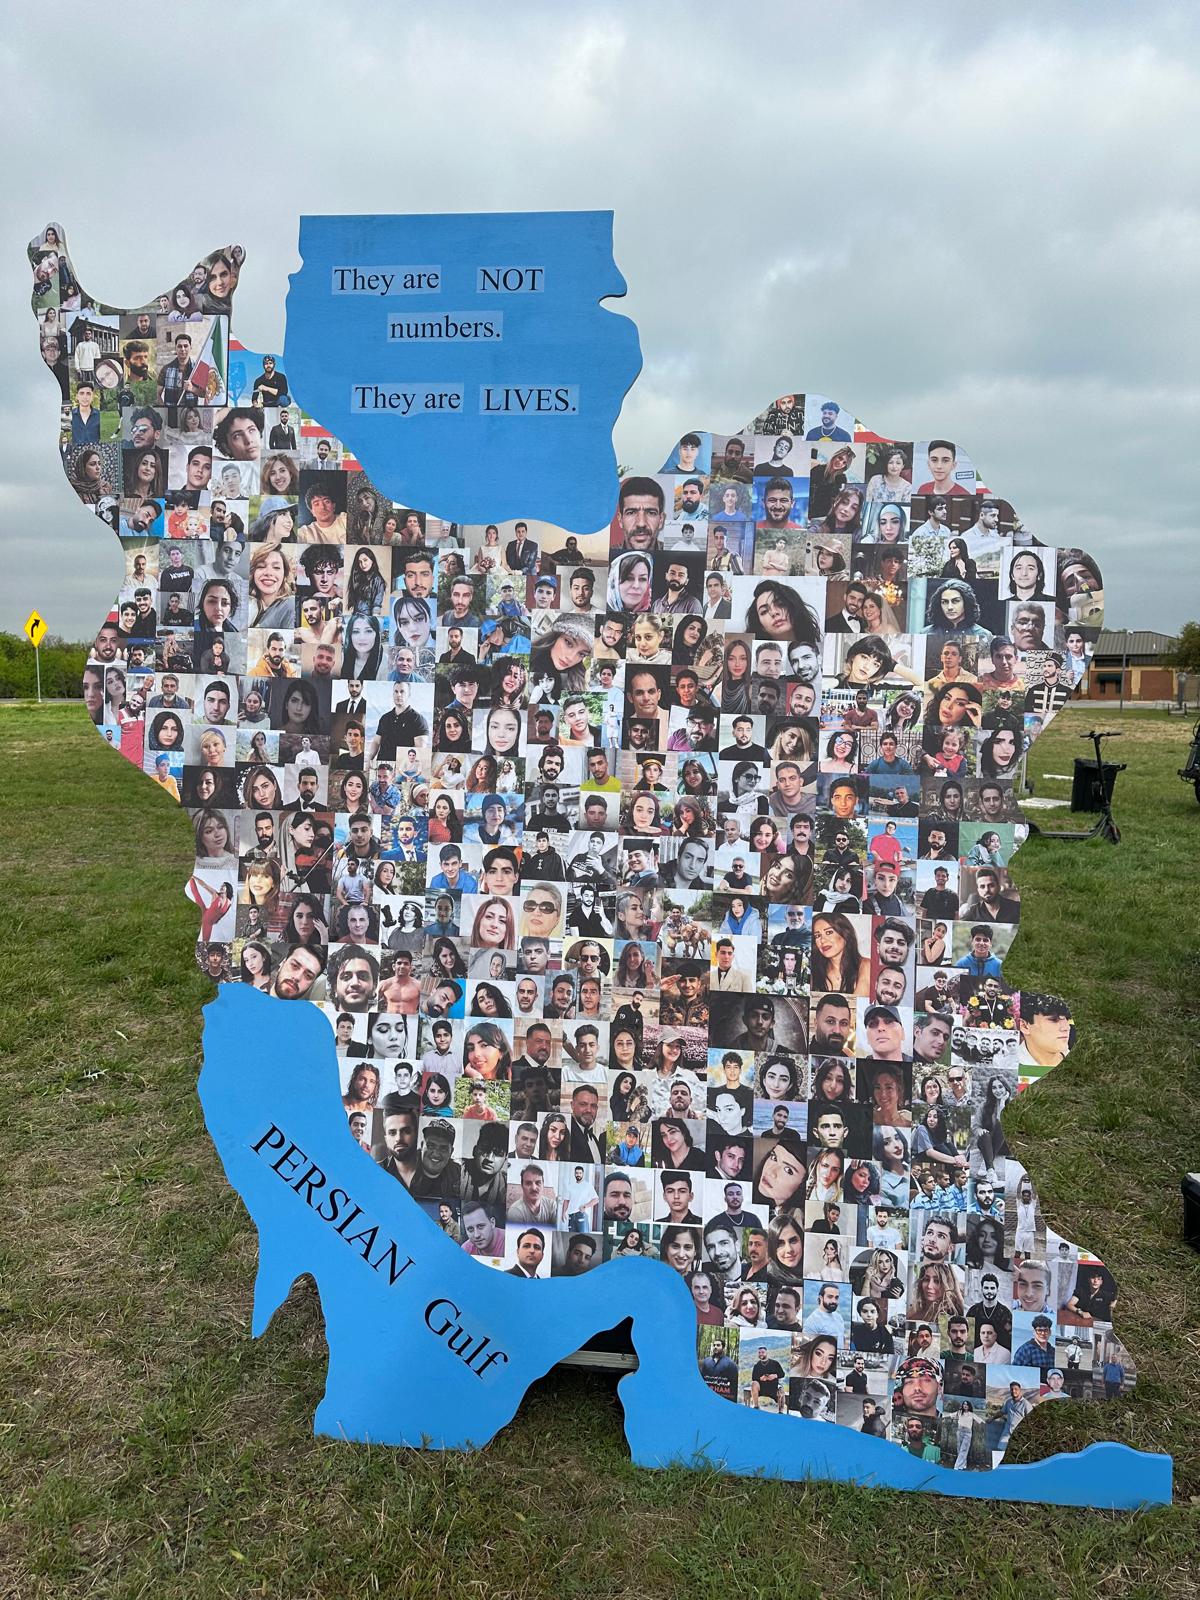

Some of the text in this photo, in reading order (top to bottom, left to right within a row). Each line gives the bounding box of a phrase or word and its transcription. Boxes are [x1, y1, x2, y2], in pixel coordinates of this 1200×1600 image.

[334, 268, 543, 296] They are NOT
[390, 314, 501, 339] numbers.
[355, 386, 576, 415] They are LIVES.
[250, 1122, 508, 1379] PERSIAN Gulf
